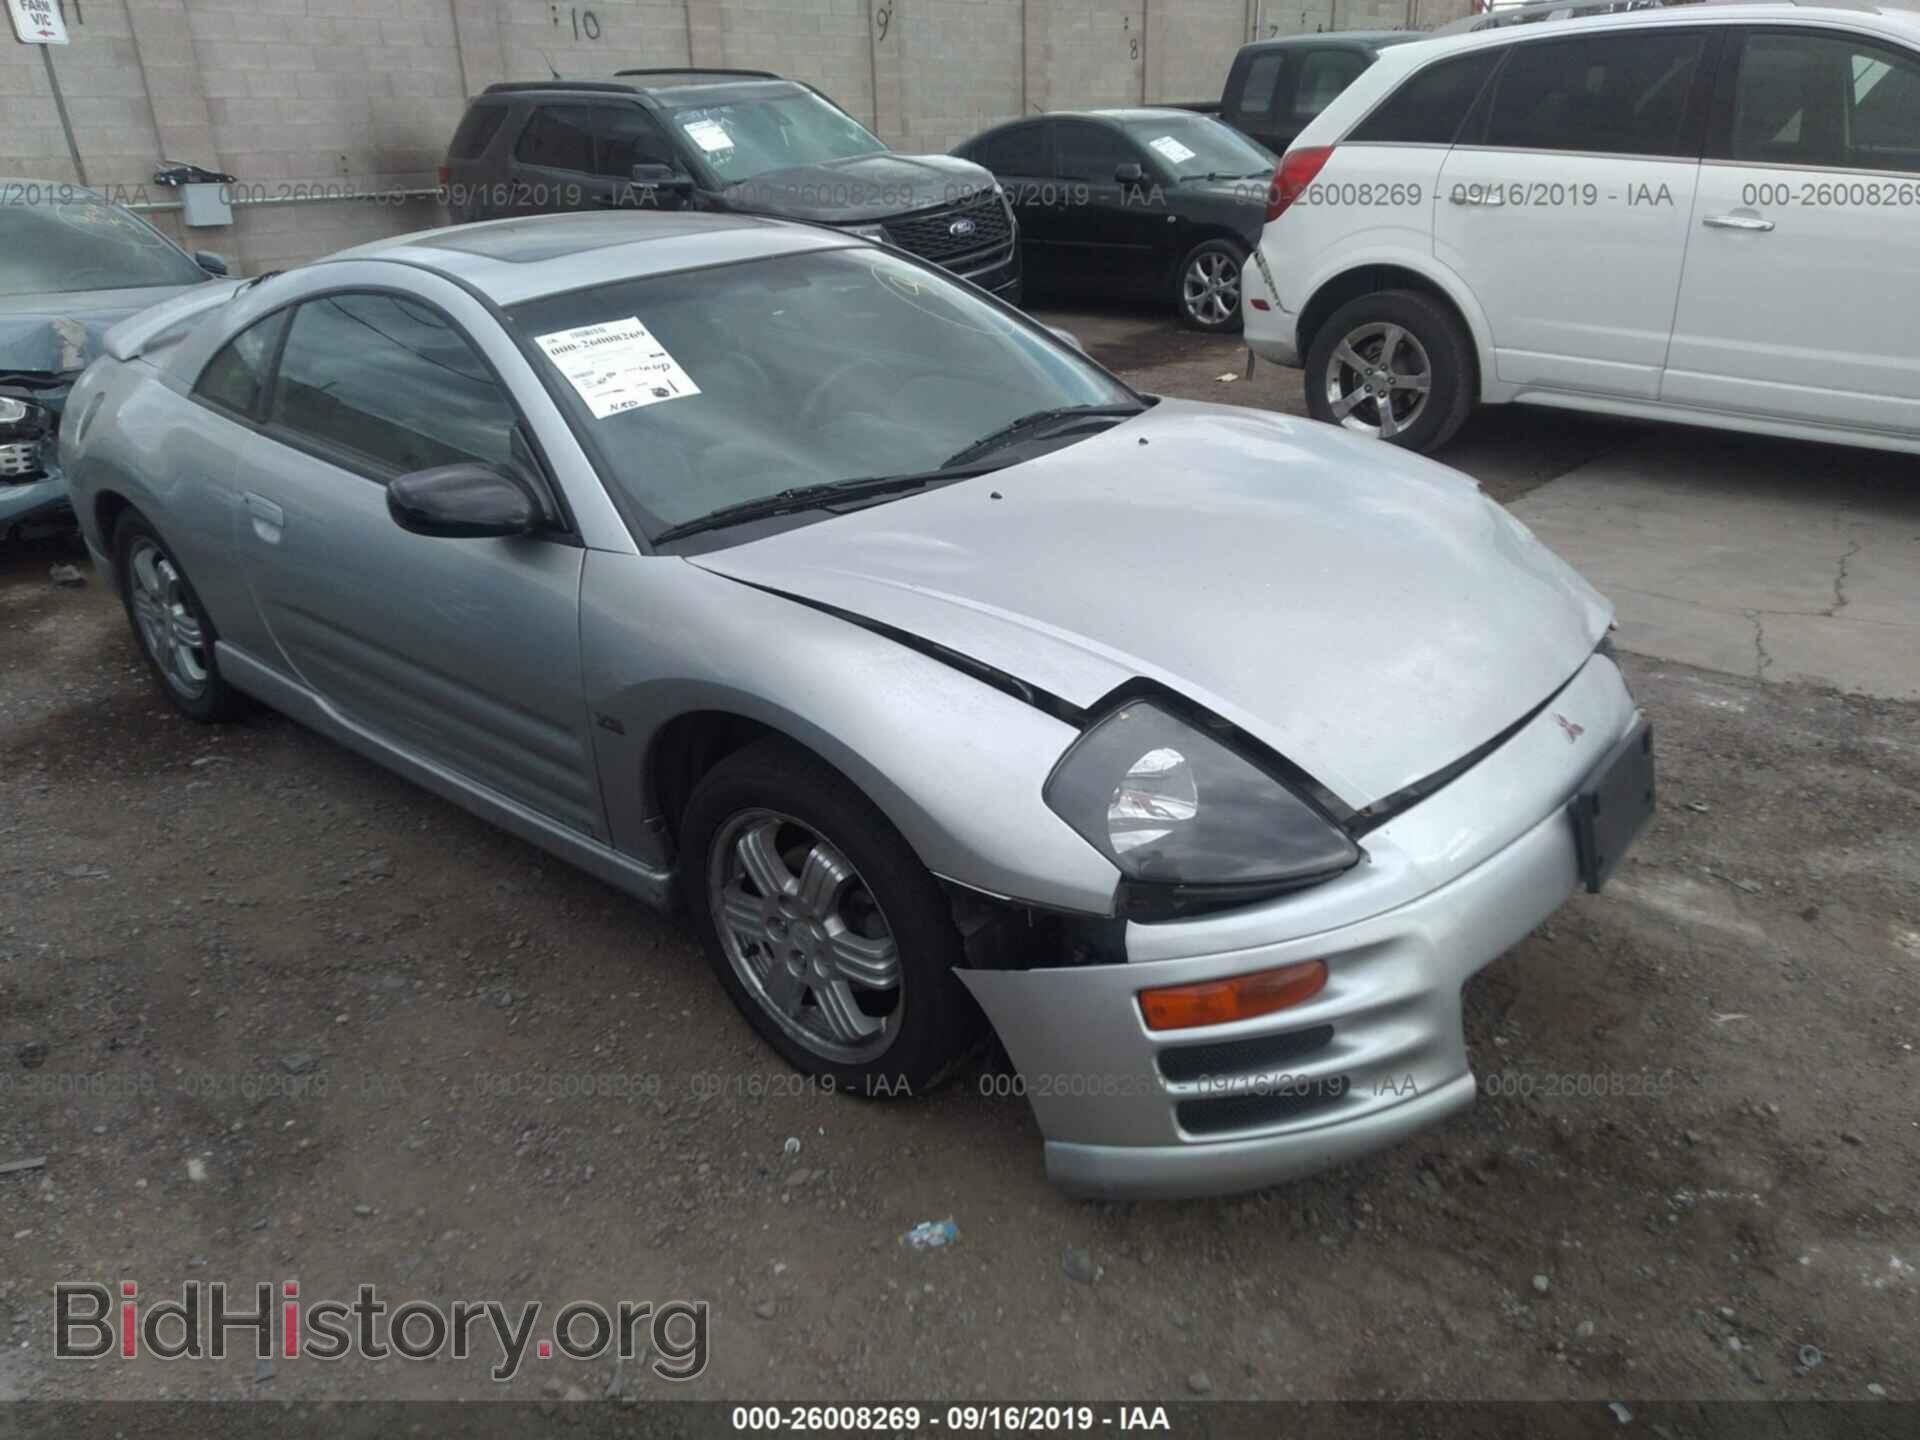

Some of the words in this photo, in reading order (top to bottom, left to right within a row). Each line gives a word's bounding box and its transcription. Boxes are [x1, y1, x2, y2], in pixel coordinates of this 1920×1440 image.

[571, 8, 601, 40] 10
[876, 8, 889, 42] 9
[1129, 38, 1138, 60] 8
